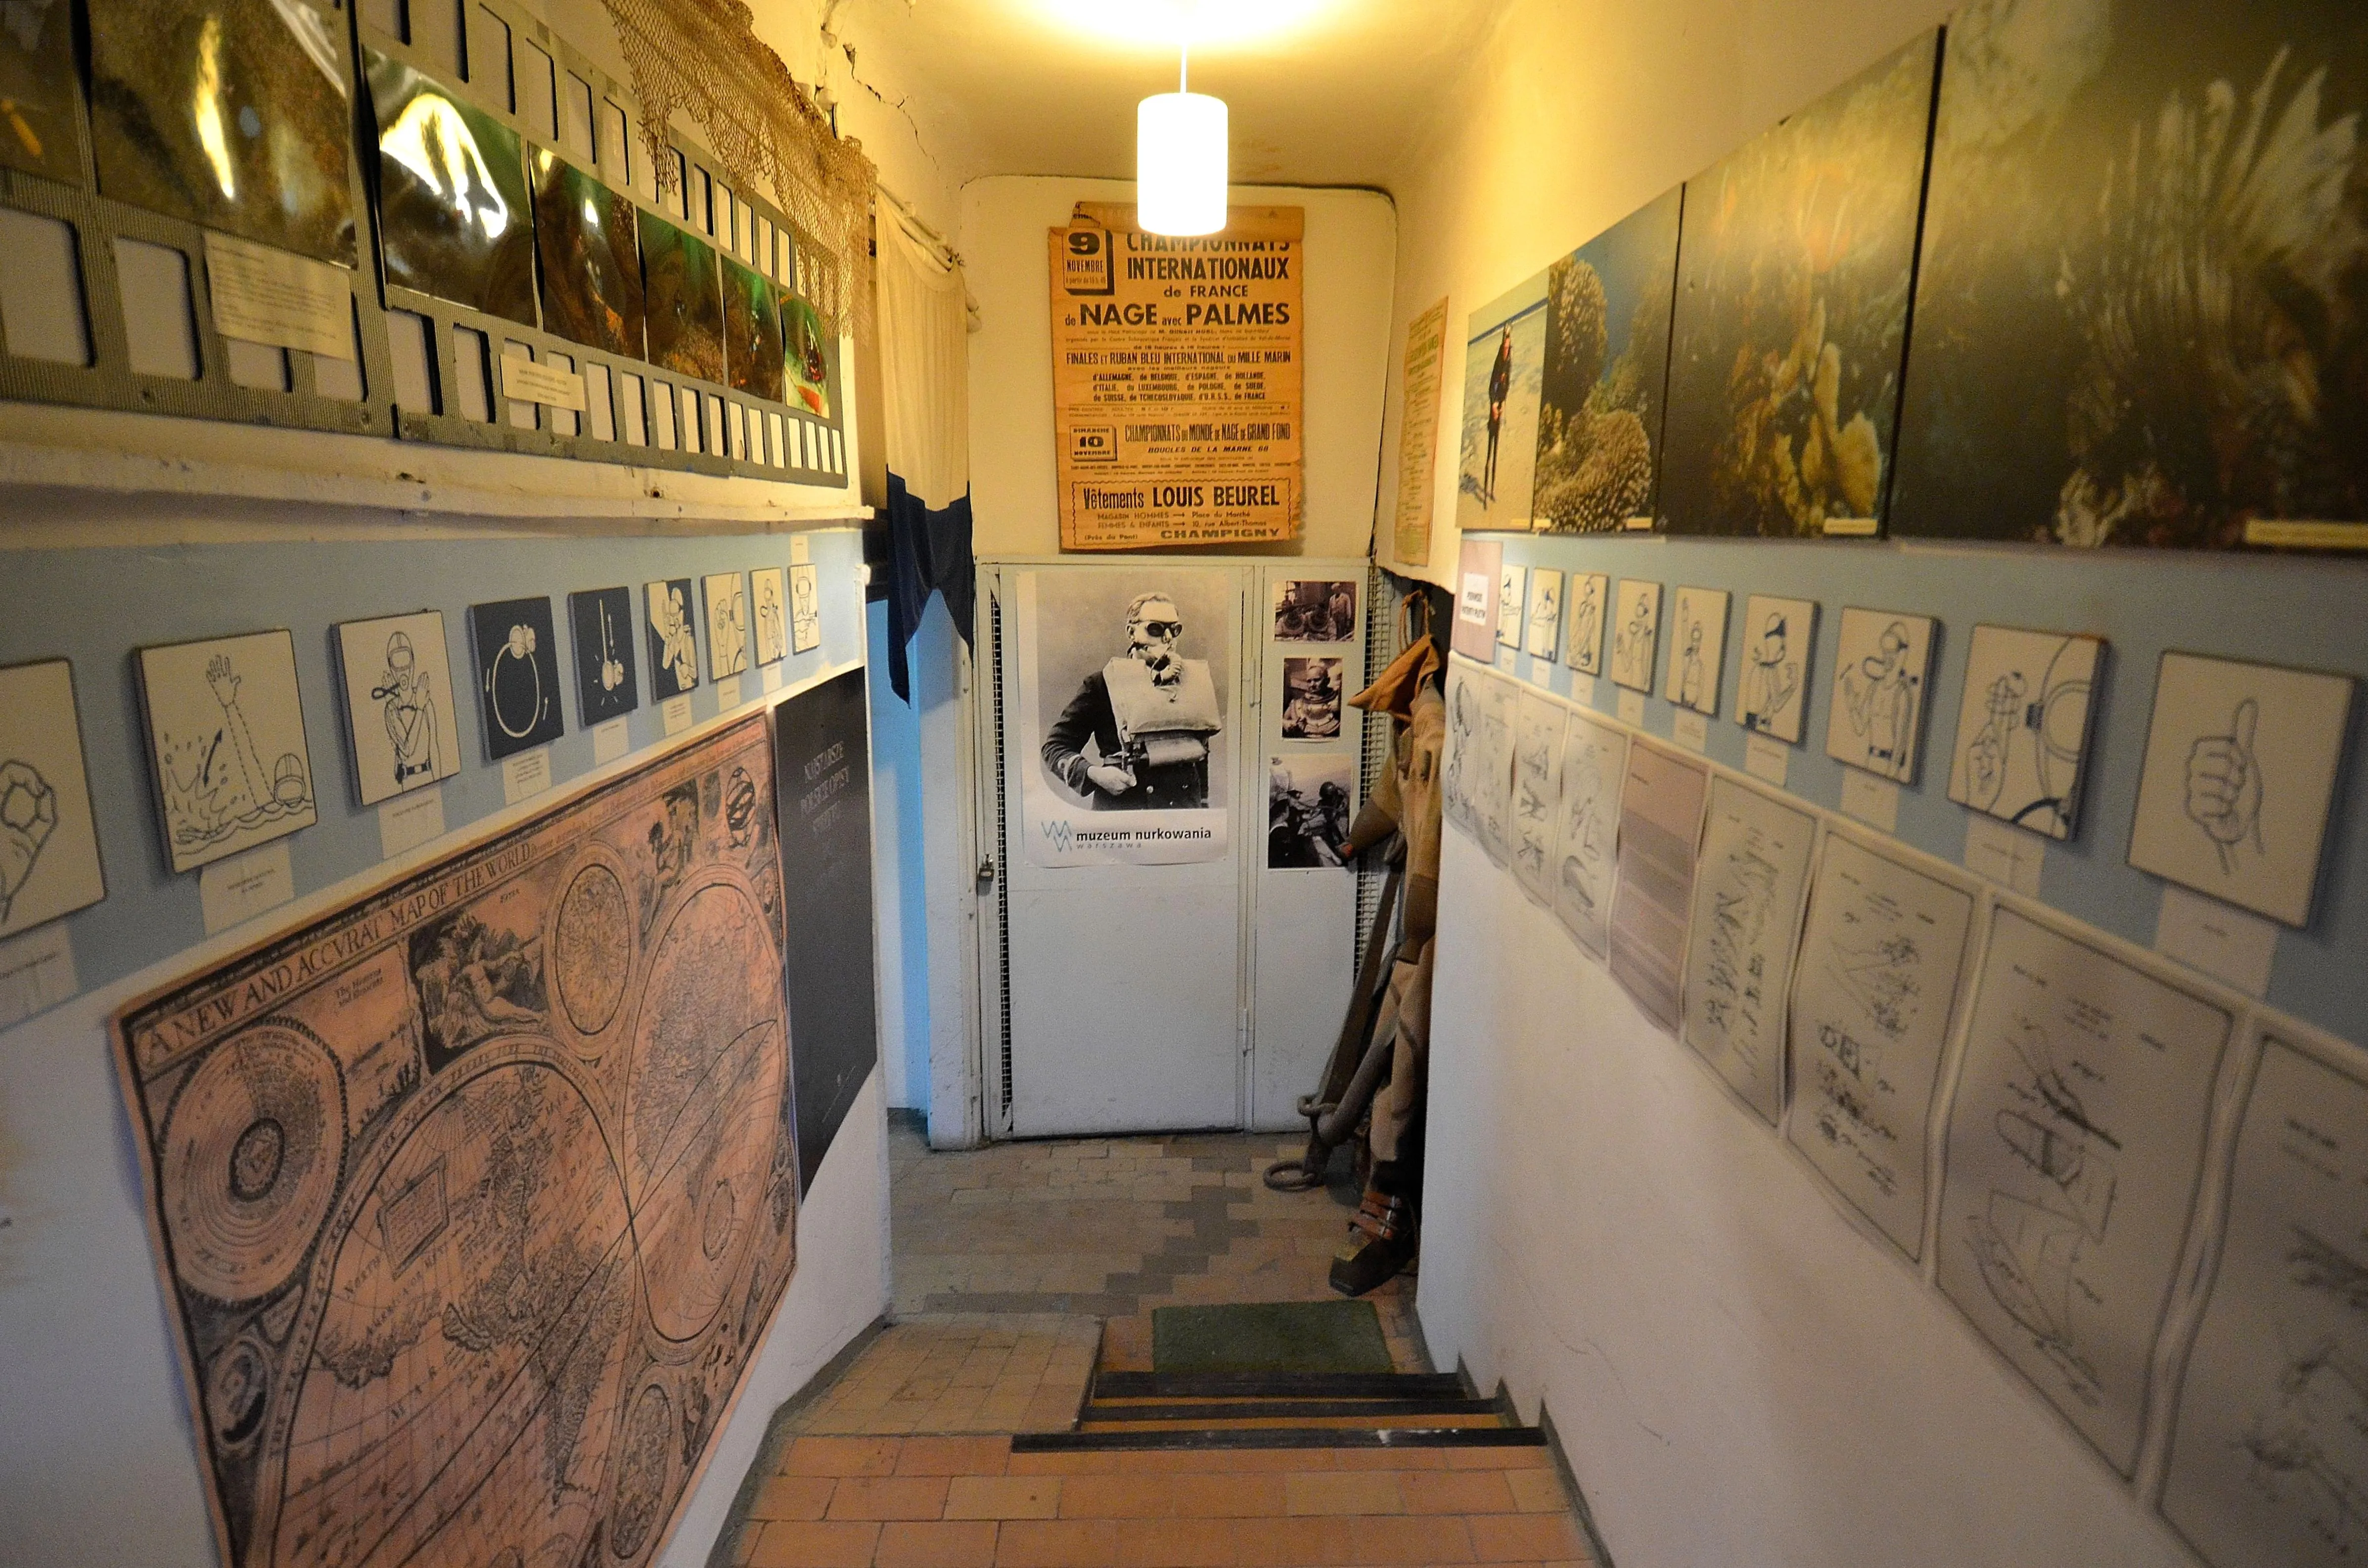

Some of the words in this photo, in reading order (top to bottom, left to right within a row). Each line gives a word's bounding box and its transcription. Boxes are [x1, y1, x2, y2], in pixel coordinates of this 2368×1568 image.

[1068, 232, 1100, 255] 9
[1066, 260, 1103, 272] NOVEMBRE
[1127, 257, 1289, 280] INTERNATIONAUX
[1164, 285, 1182, 297] de
[1190, 285, 1248, 297] FRANCE
[1065, 313, 1076, 326] de
[1080, 303, 1157, 326] NAGE
[1162, 316, 1182, 326] avec
[1186, 303, 1290, 325] PALMES
[1066, 352, 1098, 365] FINALES
[1101, 356, 1108, 364] ET
[1110, 352, 1138, 365] RUBAN
[1141, 352, 1160, 364] BLEU
[1164, 351, 1225, 364] INTERNATIONAL
[1228, 355, 1236, 363] DU
[1238, 351, 1261, 363] MILLE
[1264, 350, 1290, 363] MARIN
[1185, 372, 1219, 381] d'ESPAGNE,
[1104, 394, 1126, 402] SUISSE,
[1125, 423, 1181, 443] CHAMPIONNATS
[1189, 423, 1214, 442] MONDE
[1222, 423, 1239, 442] NAGE
[1247, 423, 1270, 441] GRAND
[1272, 423, 1290, 441] FOND
[1079, 436, 1104, 448] 10
[1083, 487, 1144, 510] Vêtements
[1153, 486, 1204, 507] LOUIS
[1214, 486, 1280, 507] BEUREL
[1161, 528, 1279, 539] CHAMPIGNY
[1076, 830, 1131, 841] muzeum
[1136, 827, 1211, 840] nurkowania
[148, 1029, 173, 1066] A
[172, 989, 237, 1047] NEW
[243, 964, 293, 1012] AND
[389, 894, 426, 931] MAP
[428, 879, 453, 910] OF
[451, 865, 485, 897] THE
[484, 841, 531, 879] WORLD
